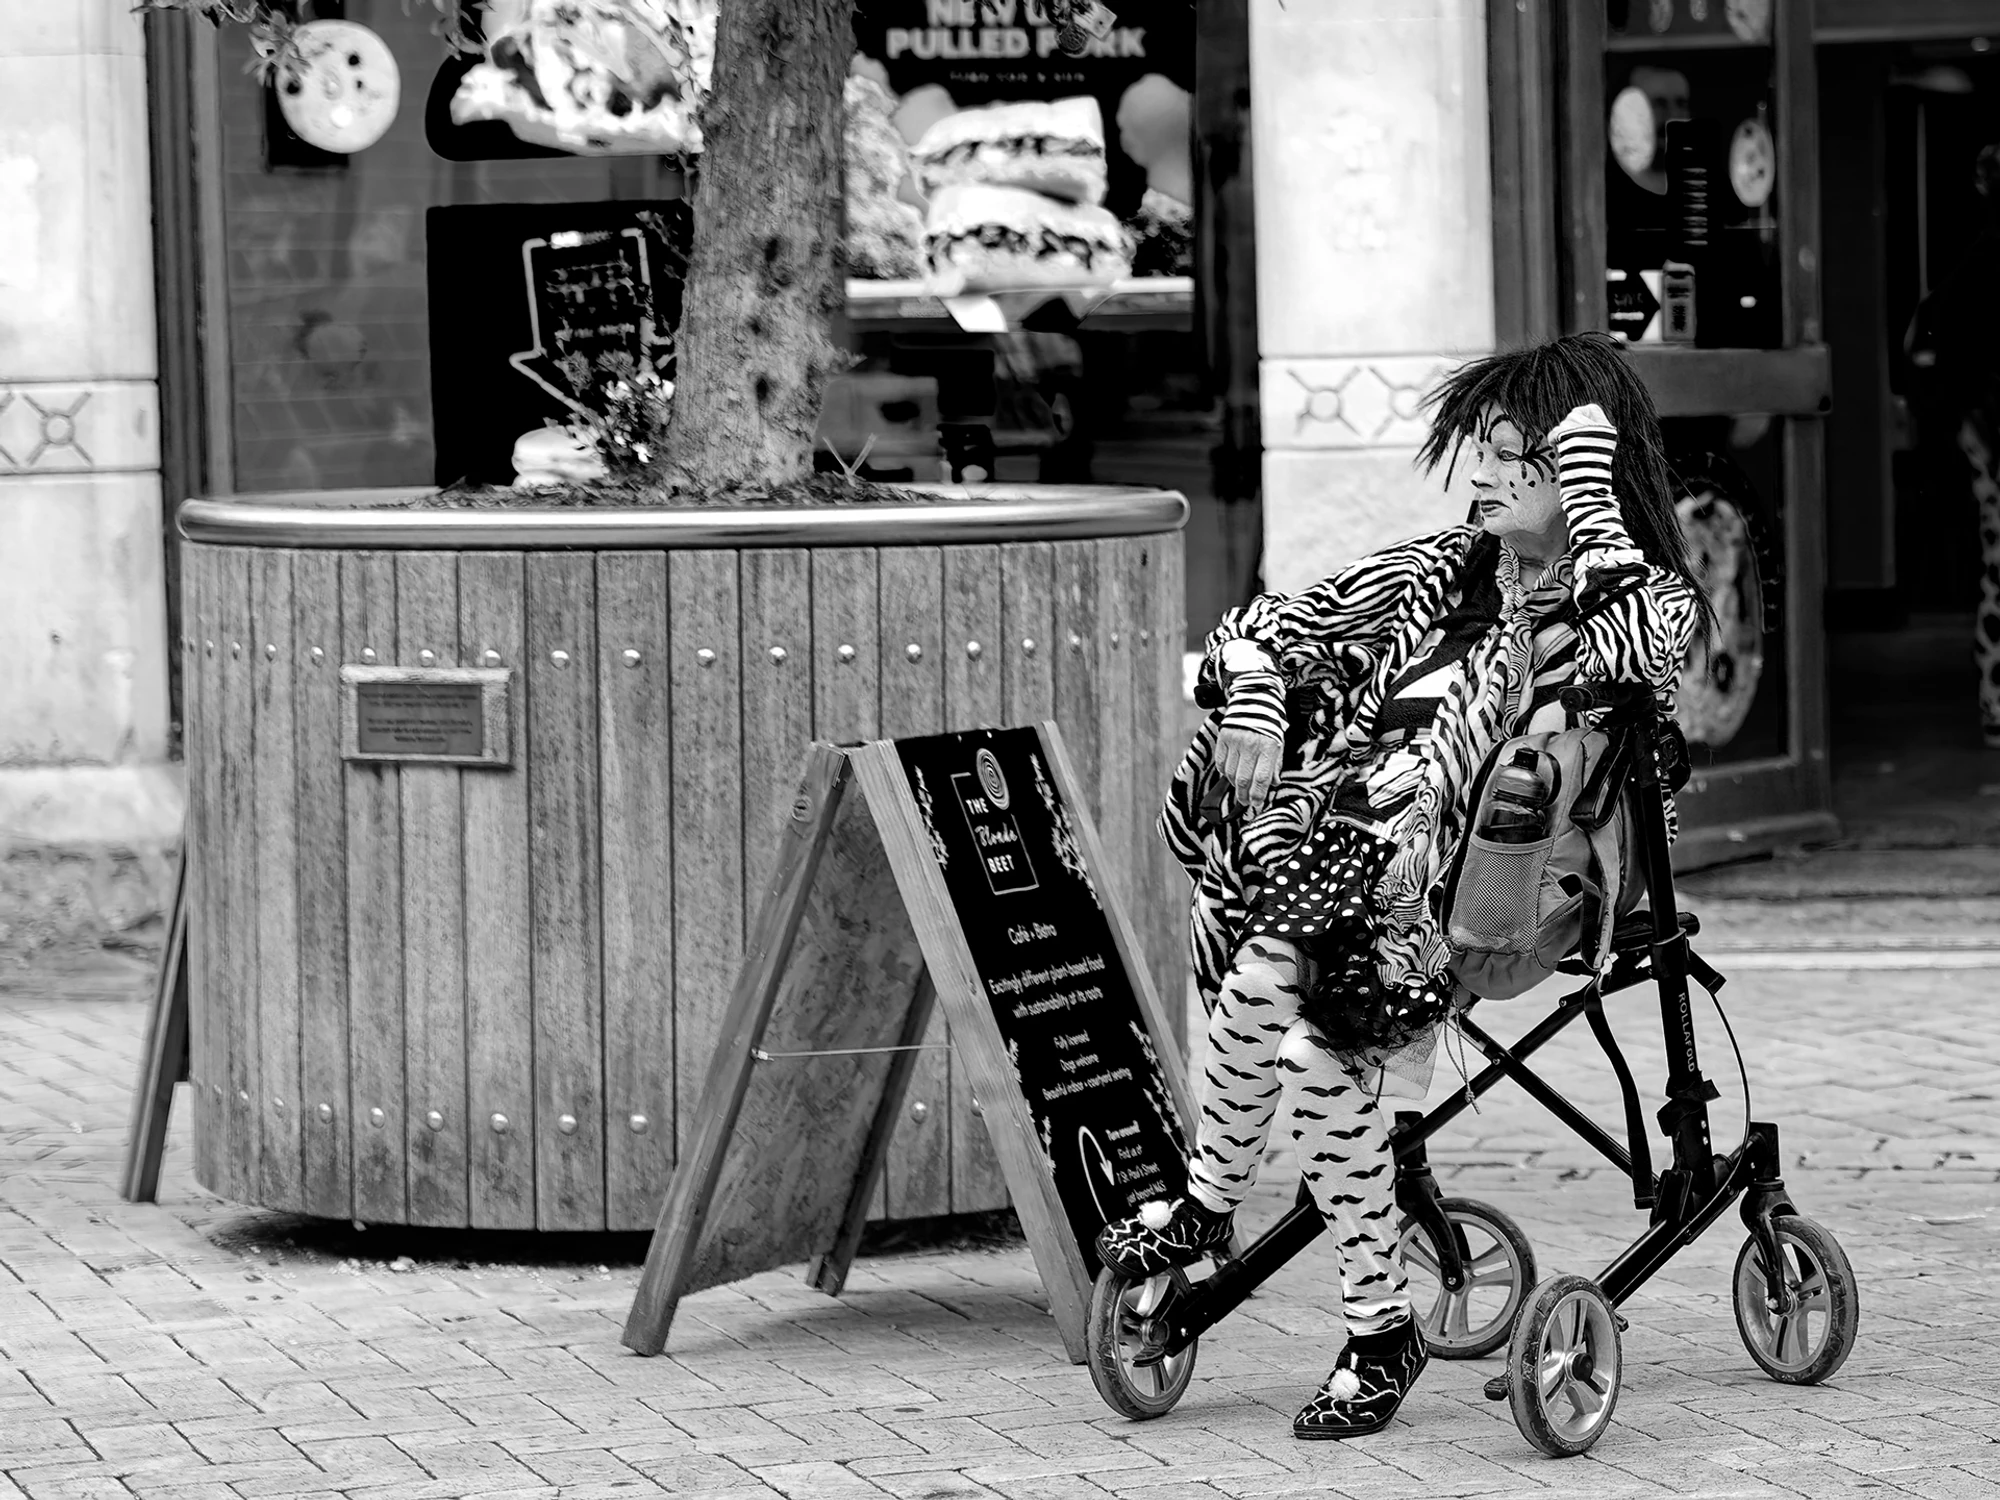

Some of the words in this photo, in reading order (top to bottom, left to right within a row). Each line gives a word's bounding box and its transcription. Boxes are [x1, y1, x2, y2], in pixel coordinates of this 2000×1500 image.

[886, 28, 1030, 59] PULLED
[1036, 27, 1147, 59] PRK
[965, 797, 989, 815] THE
[987, 854, 1015, 873] BEET
[1008, 924, 1030, 945] Café
[1033, 923, 1057, 940] Bistro
[1021, 969, 1051, 988] different
[1049, 957, 1090, 985] plant-based
[1086, 954, 1105, 971] food
[1027, 992, 1070, 1016] sustainability
[1084, 986, 1103, 1001] roots
[1679, 992, 1695, 1072] ROLLAFOLD
[1053, 1035, 1069, 1050] Fully
[1075, 1053, 1100, 1067] welcome
[1117, 1147, 1132, 1159] Find
